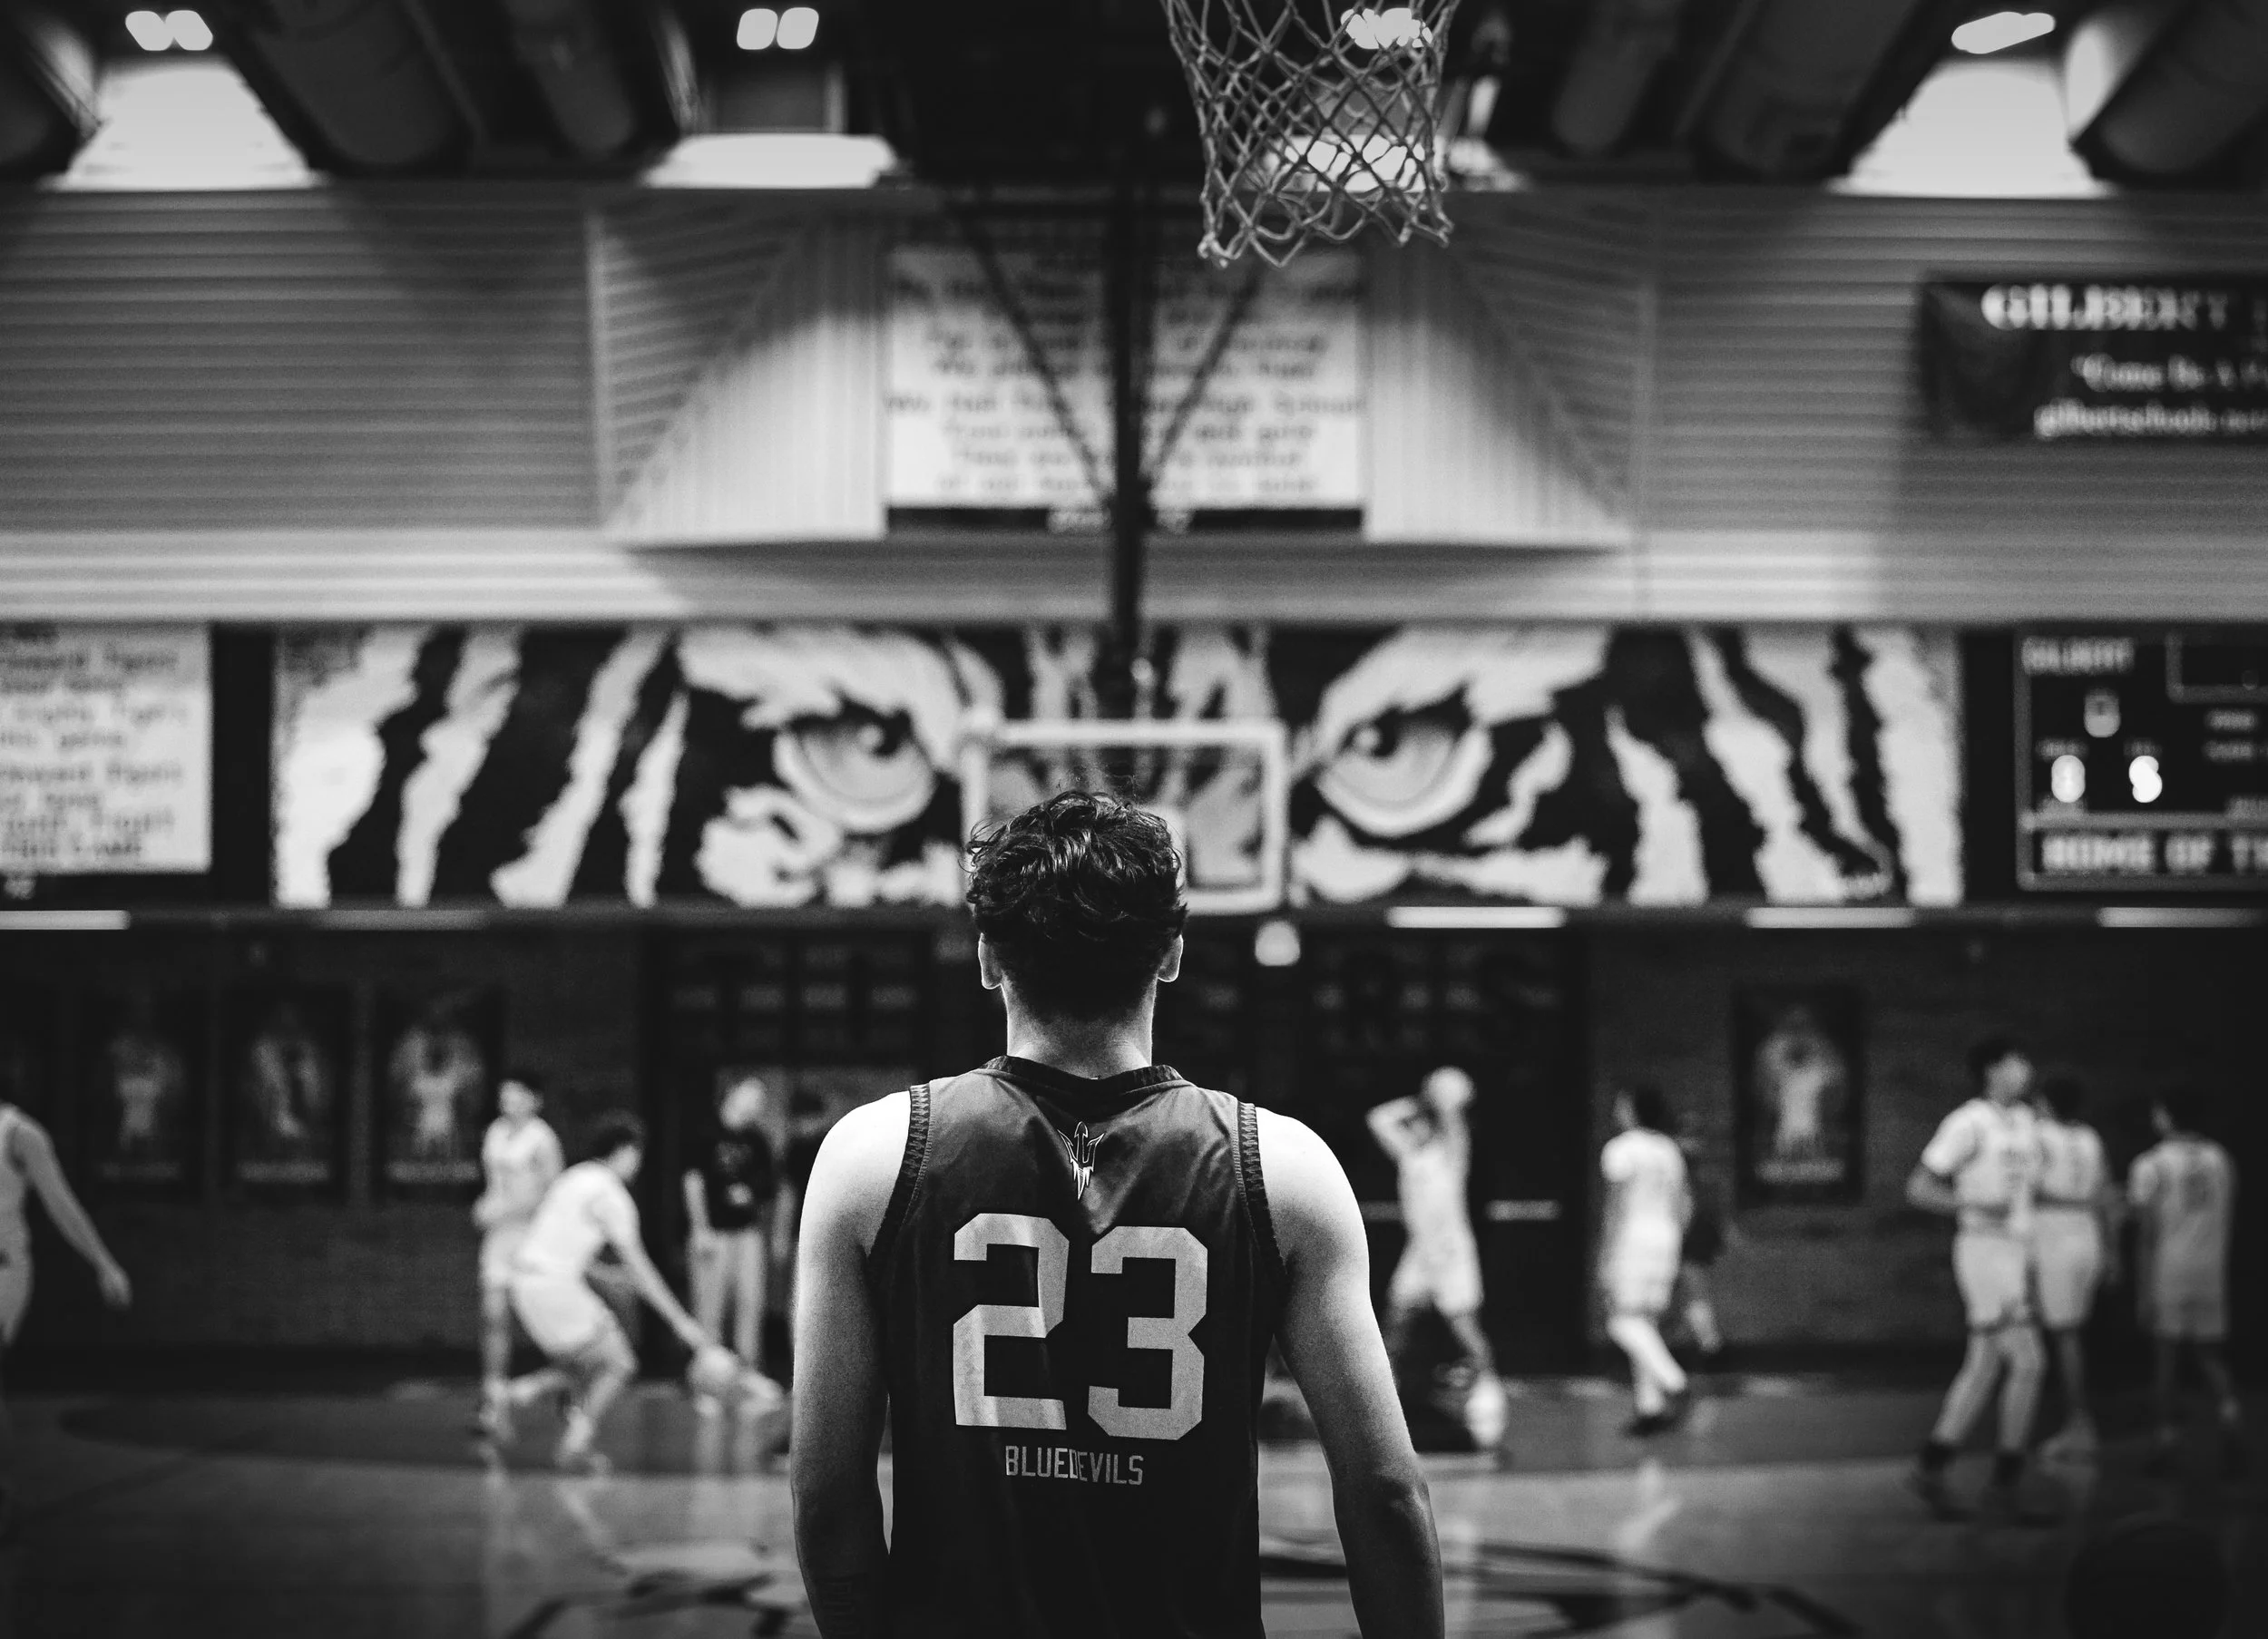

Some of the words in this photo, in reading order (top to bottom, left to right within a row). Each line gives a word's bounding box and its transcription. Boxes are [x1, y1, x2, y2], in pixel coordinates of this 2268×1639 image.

[1981, 284, 2228, 330] GILBERT
[2042, 834, 2154, 871] HOME
[2165, 834, 2212, 871] OF
[953, 1213, 1208, 1440] 23
